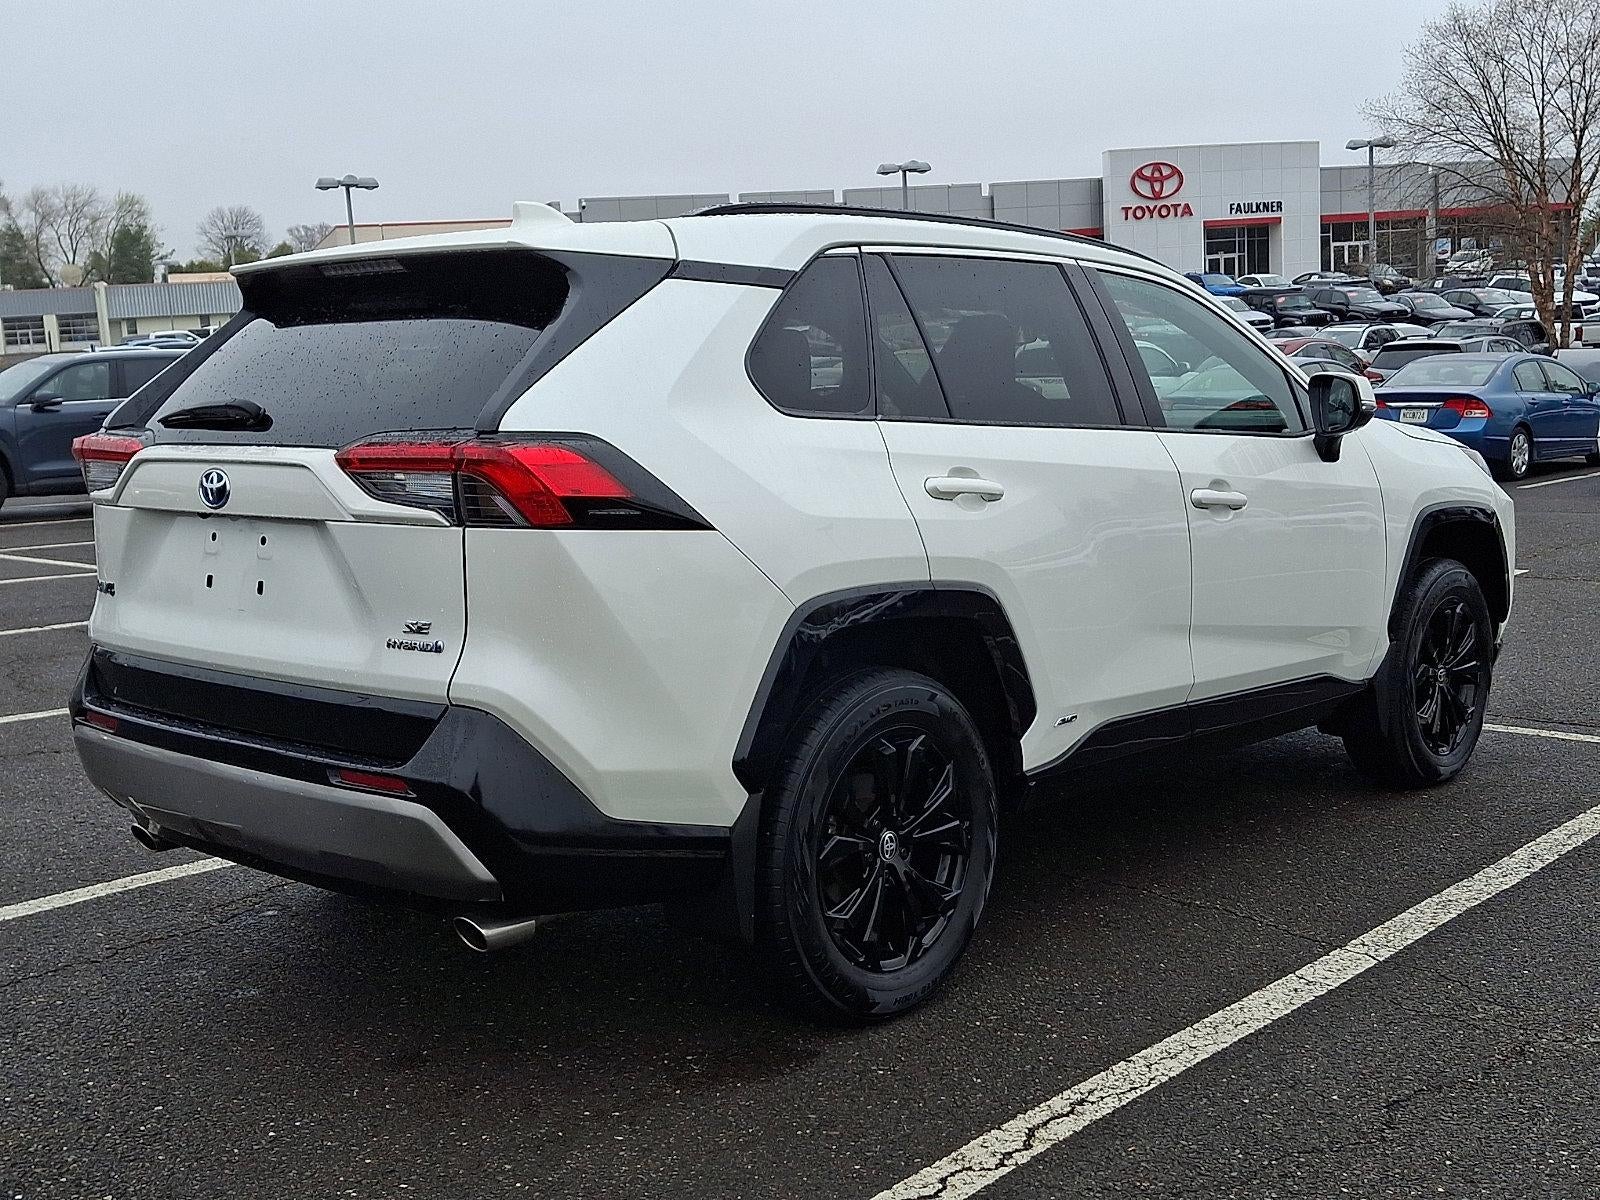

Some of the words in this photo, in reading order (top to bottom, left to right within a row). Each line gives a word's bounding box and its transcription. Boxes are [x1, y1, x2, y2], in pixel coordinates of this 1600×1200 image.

[1121, 203, 1194, 221] TOYOTA
[1229, 200, 1283, 215] FAULKNER
[402, 620, 433, 635] SE
[386, 637, 435, 653] HYBRID
